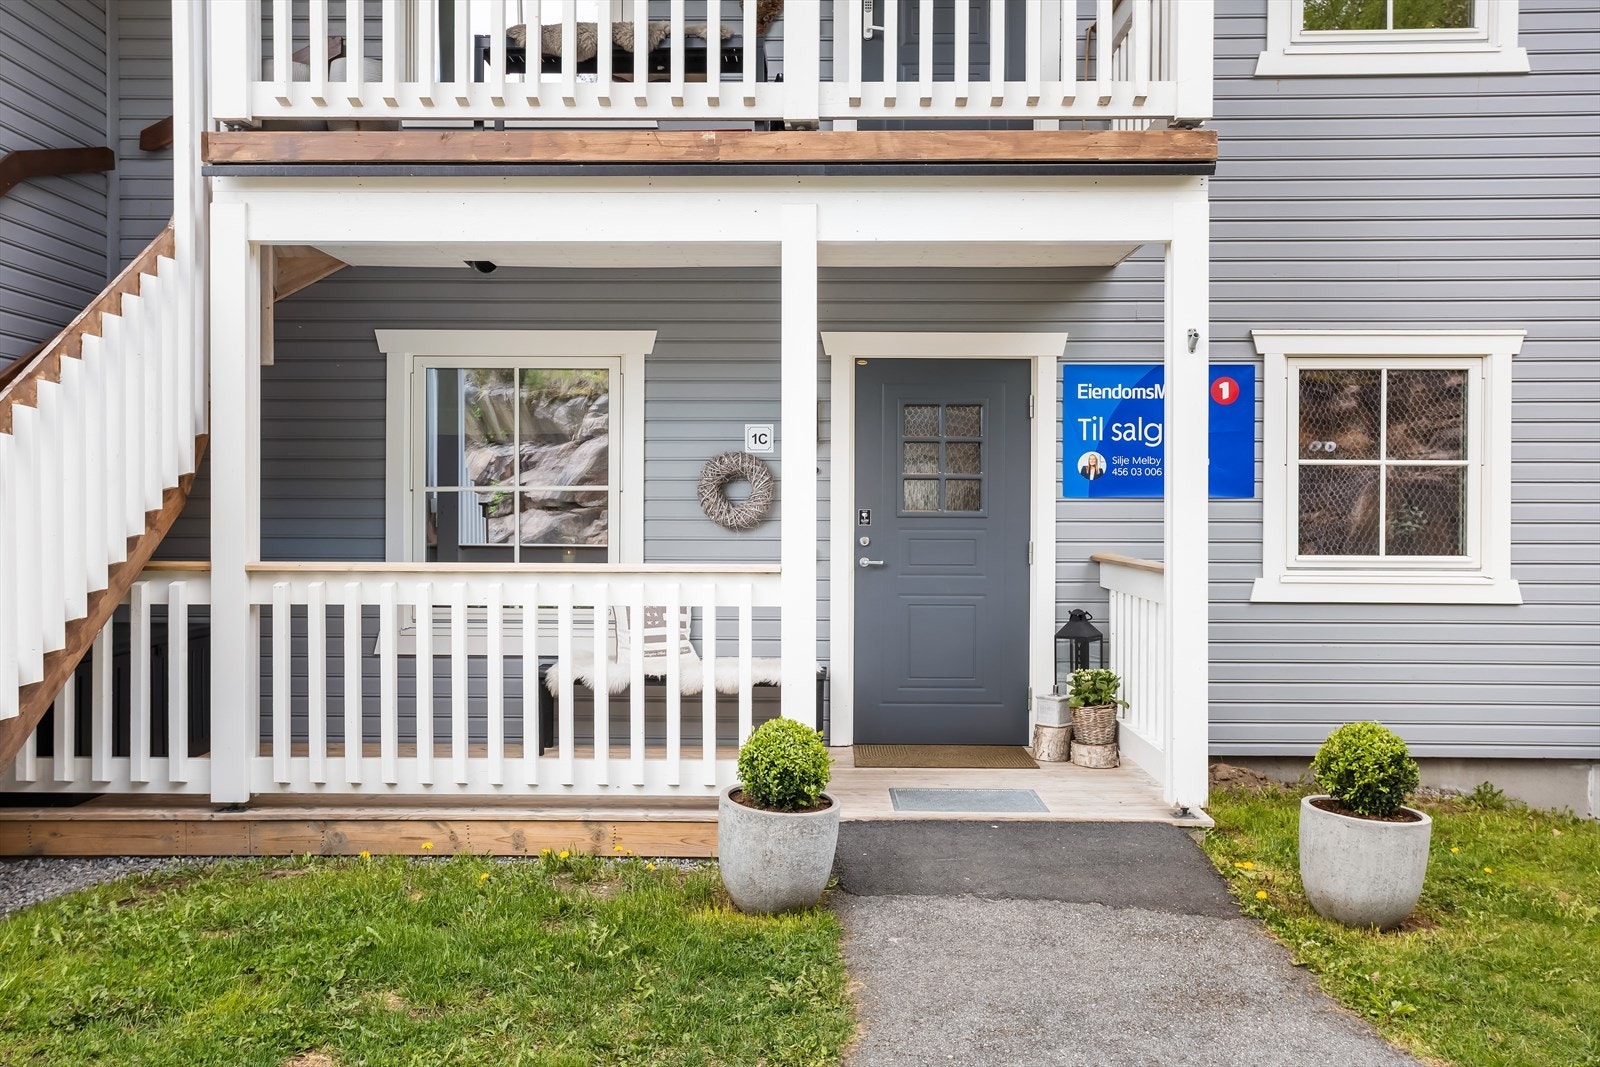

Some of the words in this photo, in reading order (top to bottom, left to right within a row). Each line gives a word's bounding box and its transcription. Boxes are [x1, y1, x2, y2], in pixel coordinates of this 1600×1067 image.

[1077, 383, 1165, 399] EiendomsM
[1219, 381, 1230, 400] 1
[1077, 416, 1103, 441] Til
[1111, 416, 1163, 447] salg
[751, 433, 768, 445] 1C
[1112, 456, 1129, 466] Silje
[1132, 456, 1161, 466] Melby
[1112, 467, 1128, 476] 456
[1131, 467, 1142, 476] 03
[1144, 467, 1162, 476] 006
